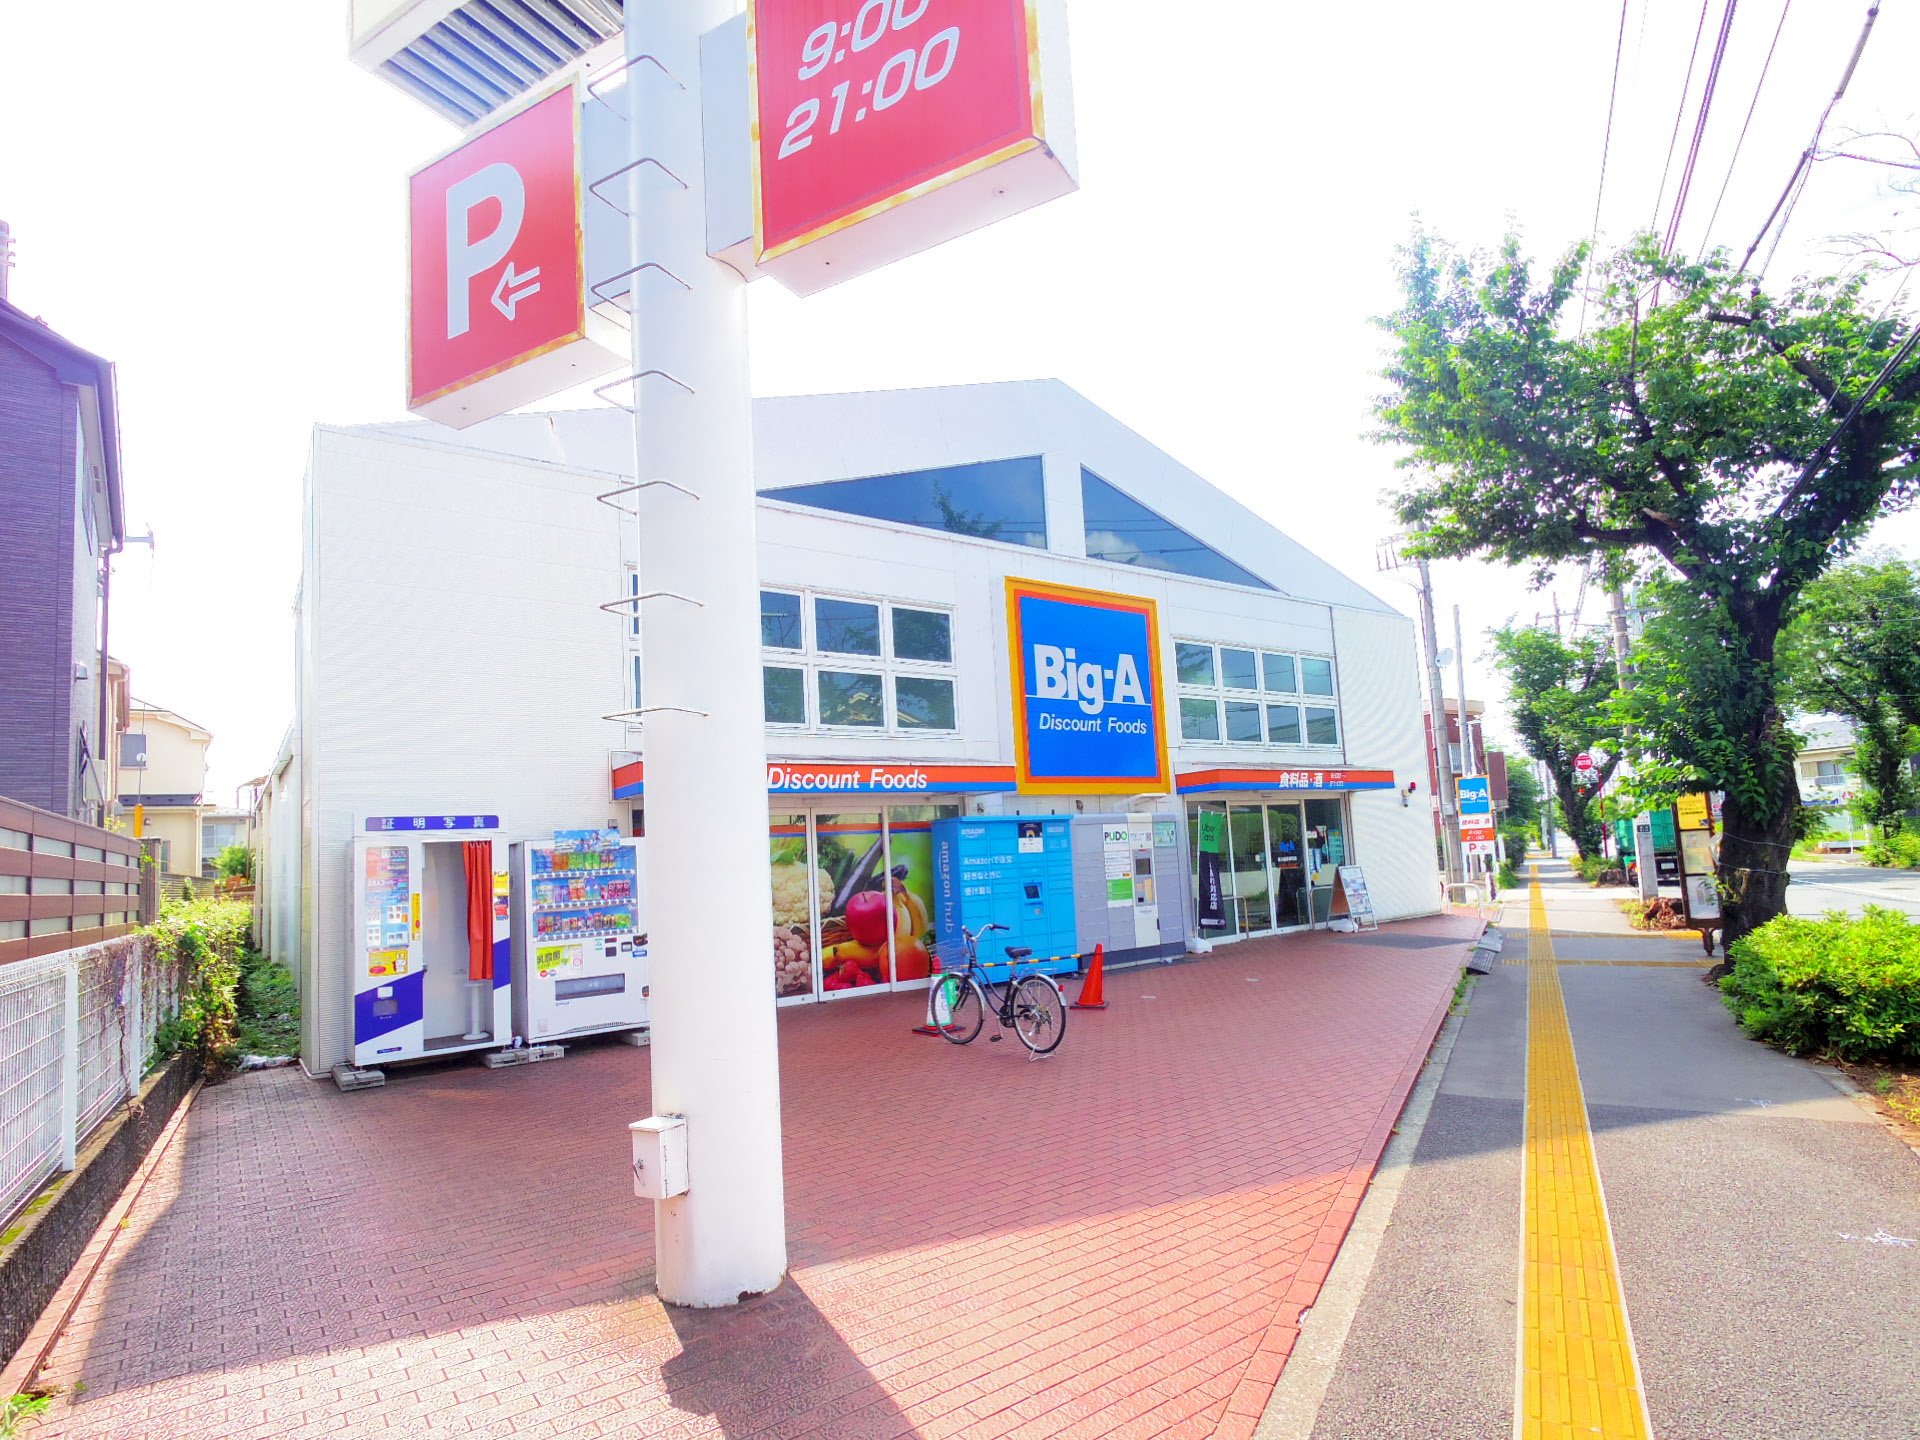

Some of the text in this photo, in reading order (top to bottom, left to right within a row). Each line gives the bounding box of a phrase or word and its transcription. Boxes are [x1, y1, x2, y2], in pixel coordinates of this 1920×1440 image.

[777, 26, 960, 161] 21:00
[446, 162, 526, 340] P
[1033, 643, 1146, 715] Big-A
[1039, 712, 1148, 735] Discount Foods
[767, 767, 928, 790] Discount Foods
[1279, 772, 1323, 788] 食料品・酒
[1460, 788, 1487, 799] Big-A
[381, 816, 485, 830] 証明写真
[961, 828, 985, 836] amazon
[1104, 831, 1128, 841] PUDO
[1469, 843, 1476, 853] P
[941, 841, 954, 933] amazon hub
